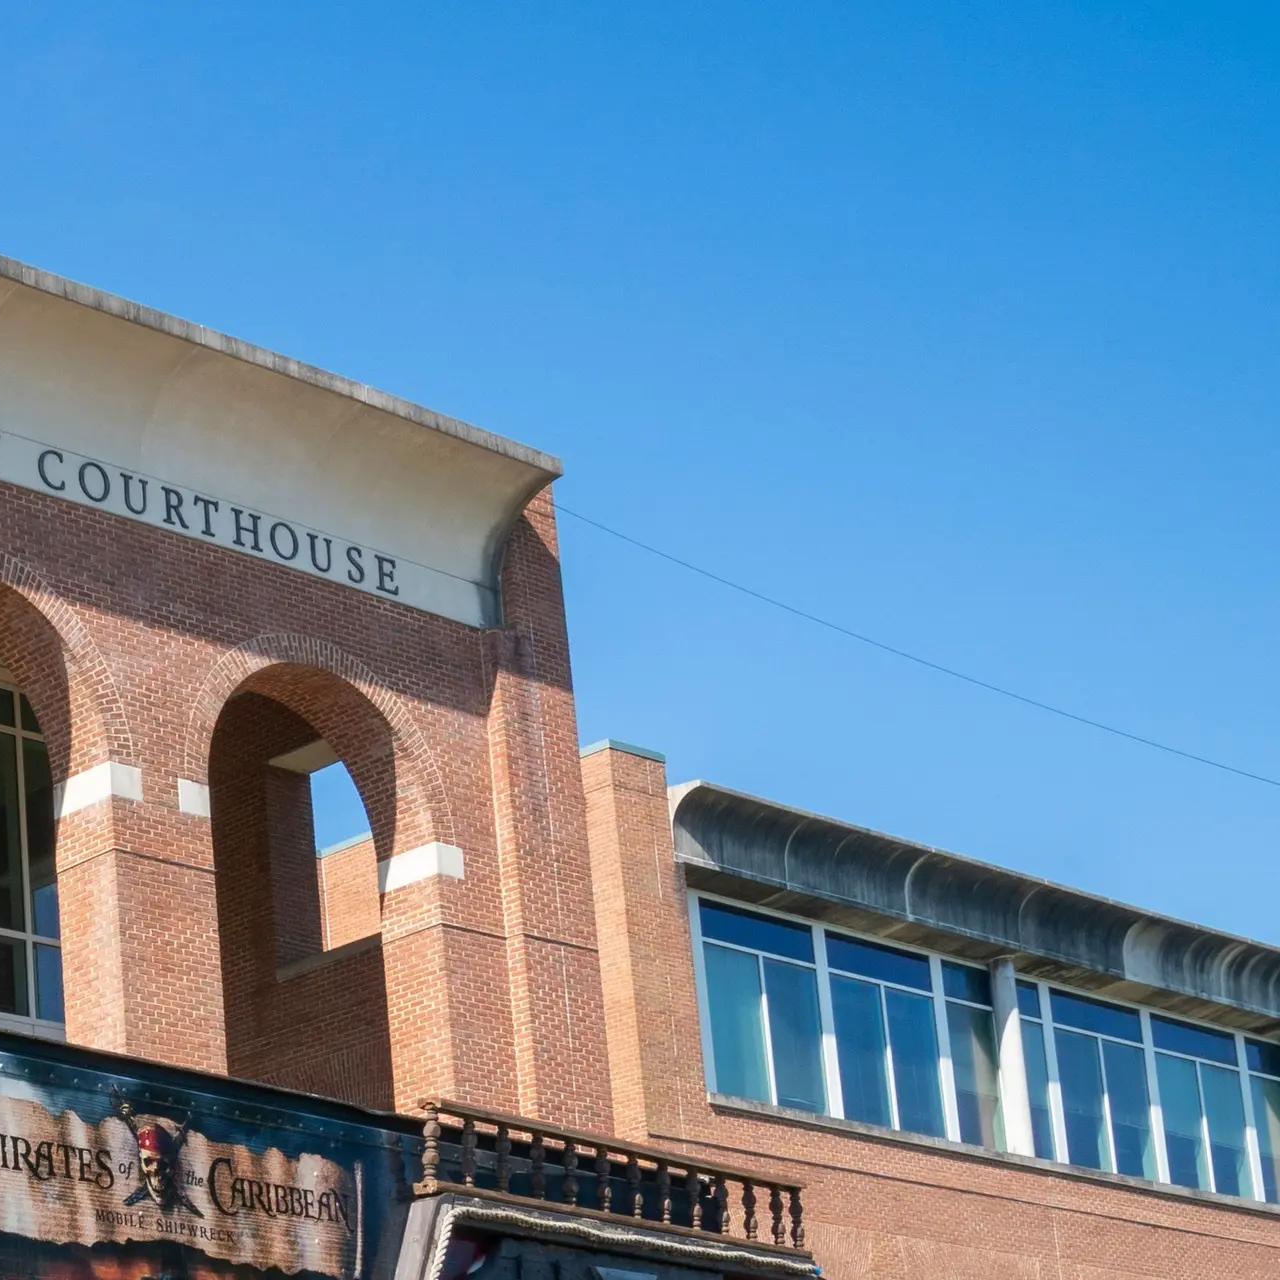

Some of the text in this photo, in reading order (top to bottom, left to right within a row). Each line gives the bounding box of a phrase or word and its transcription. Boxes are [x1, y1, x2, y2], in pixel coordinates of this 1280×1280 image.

[37, 449, 400, 597] COURTHOUSE
[95, 1208, 236, 1245] MOBILE SHIPWRECK
[118, 1161, 135, 1181] of
[185, 1169, 205, 1188] the
[206, 1157, 355, 1233] CARIBBEAN
